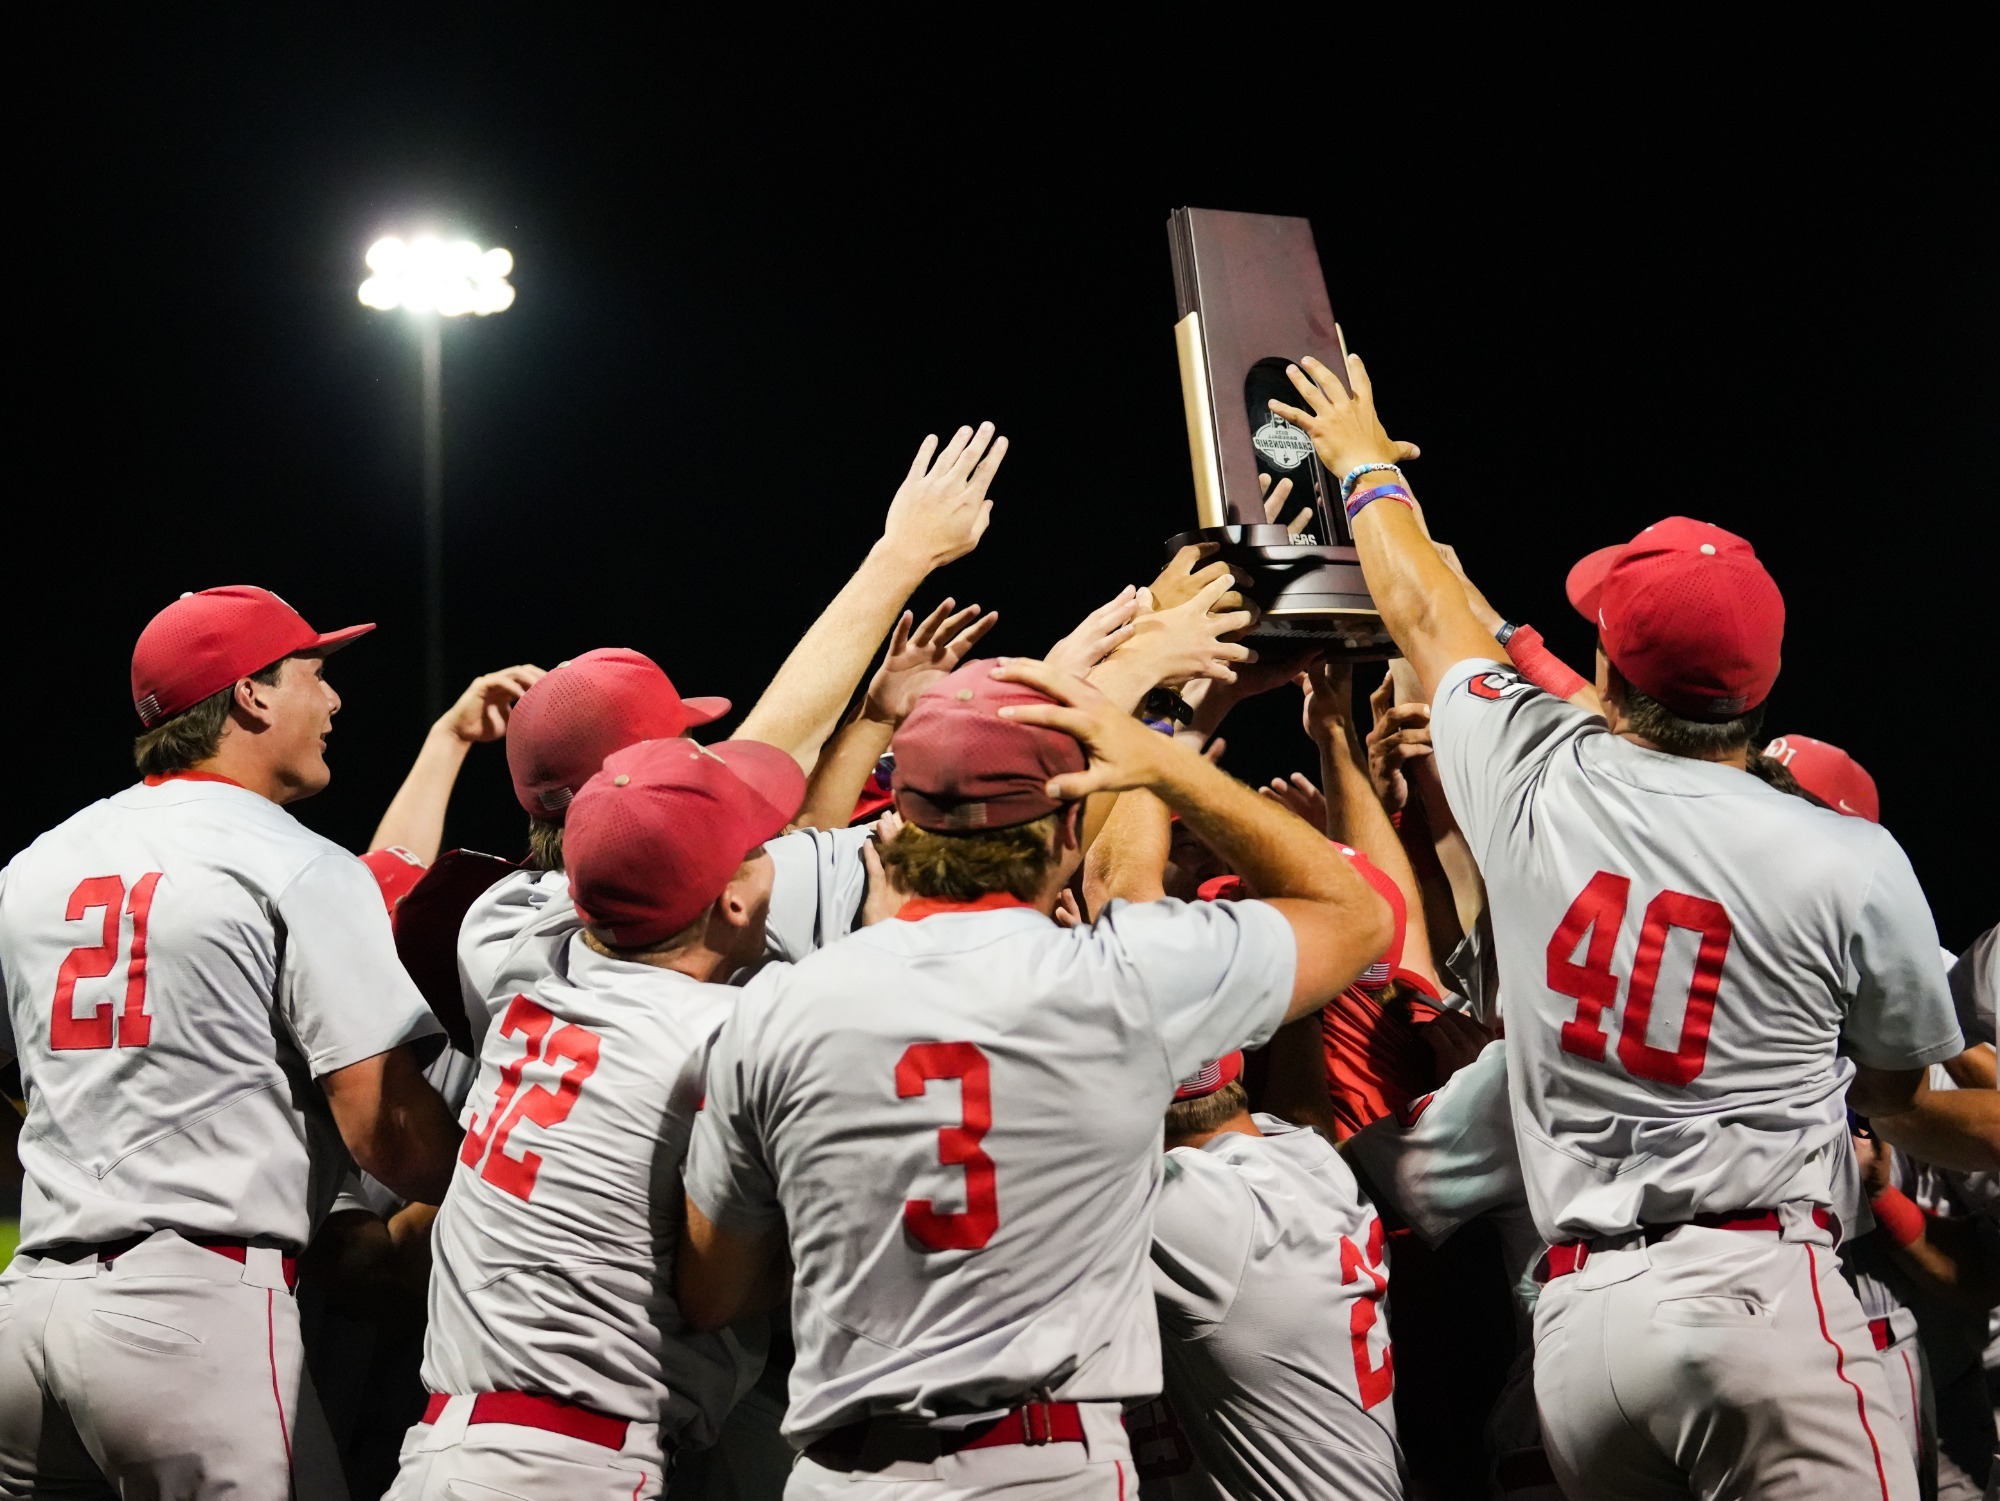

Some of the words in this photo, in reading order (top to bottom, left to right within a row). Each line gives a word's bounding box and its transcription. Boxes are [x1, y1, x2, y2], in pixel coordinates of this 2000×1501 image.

[50, 871, 164, 1051] 21
[1545, 869, 1733, 1088] 40
[459, 992, 602, 1204] 32
[894, 1040, 1000, 1251] 3
